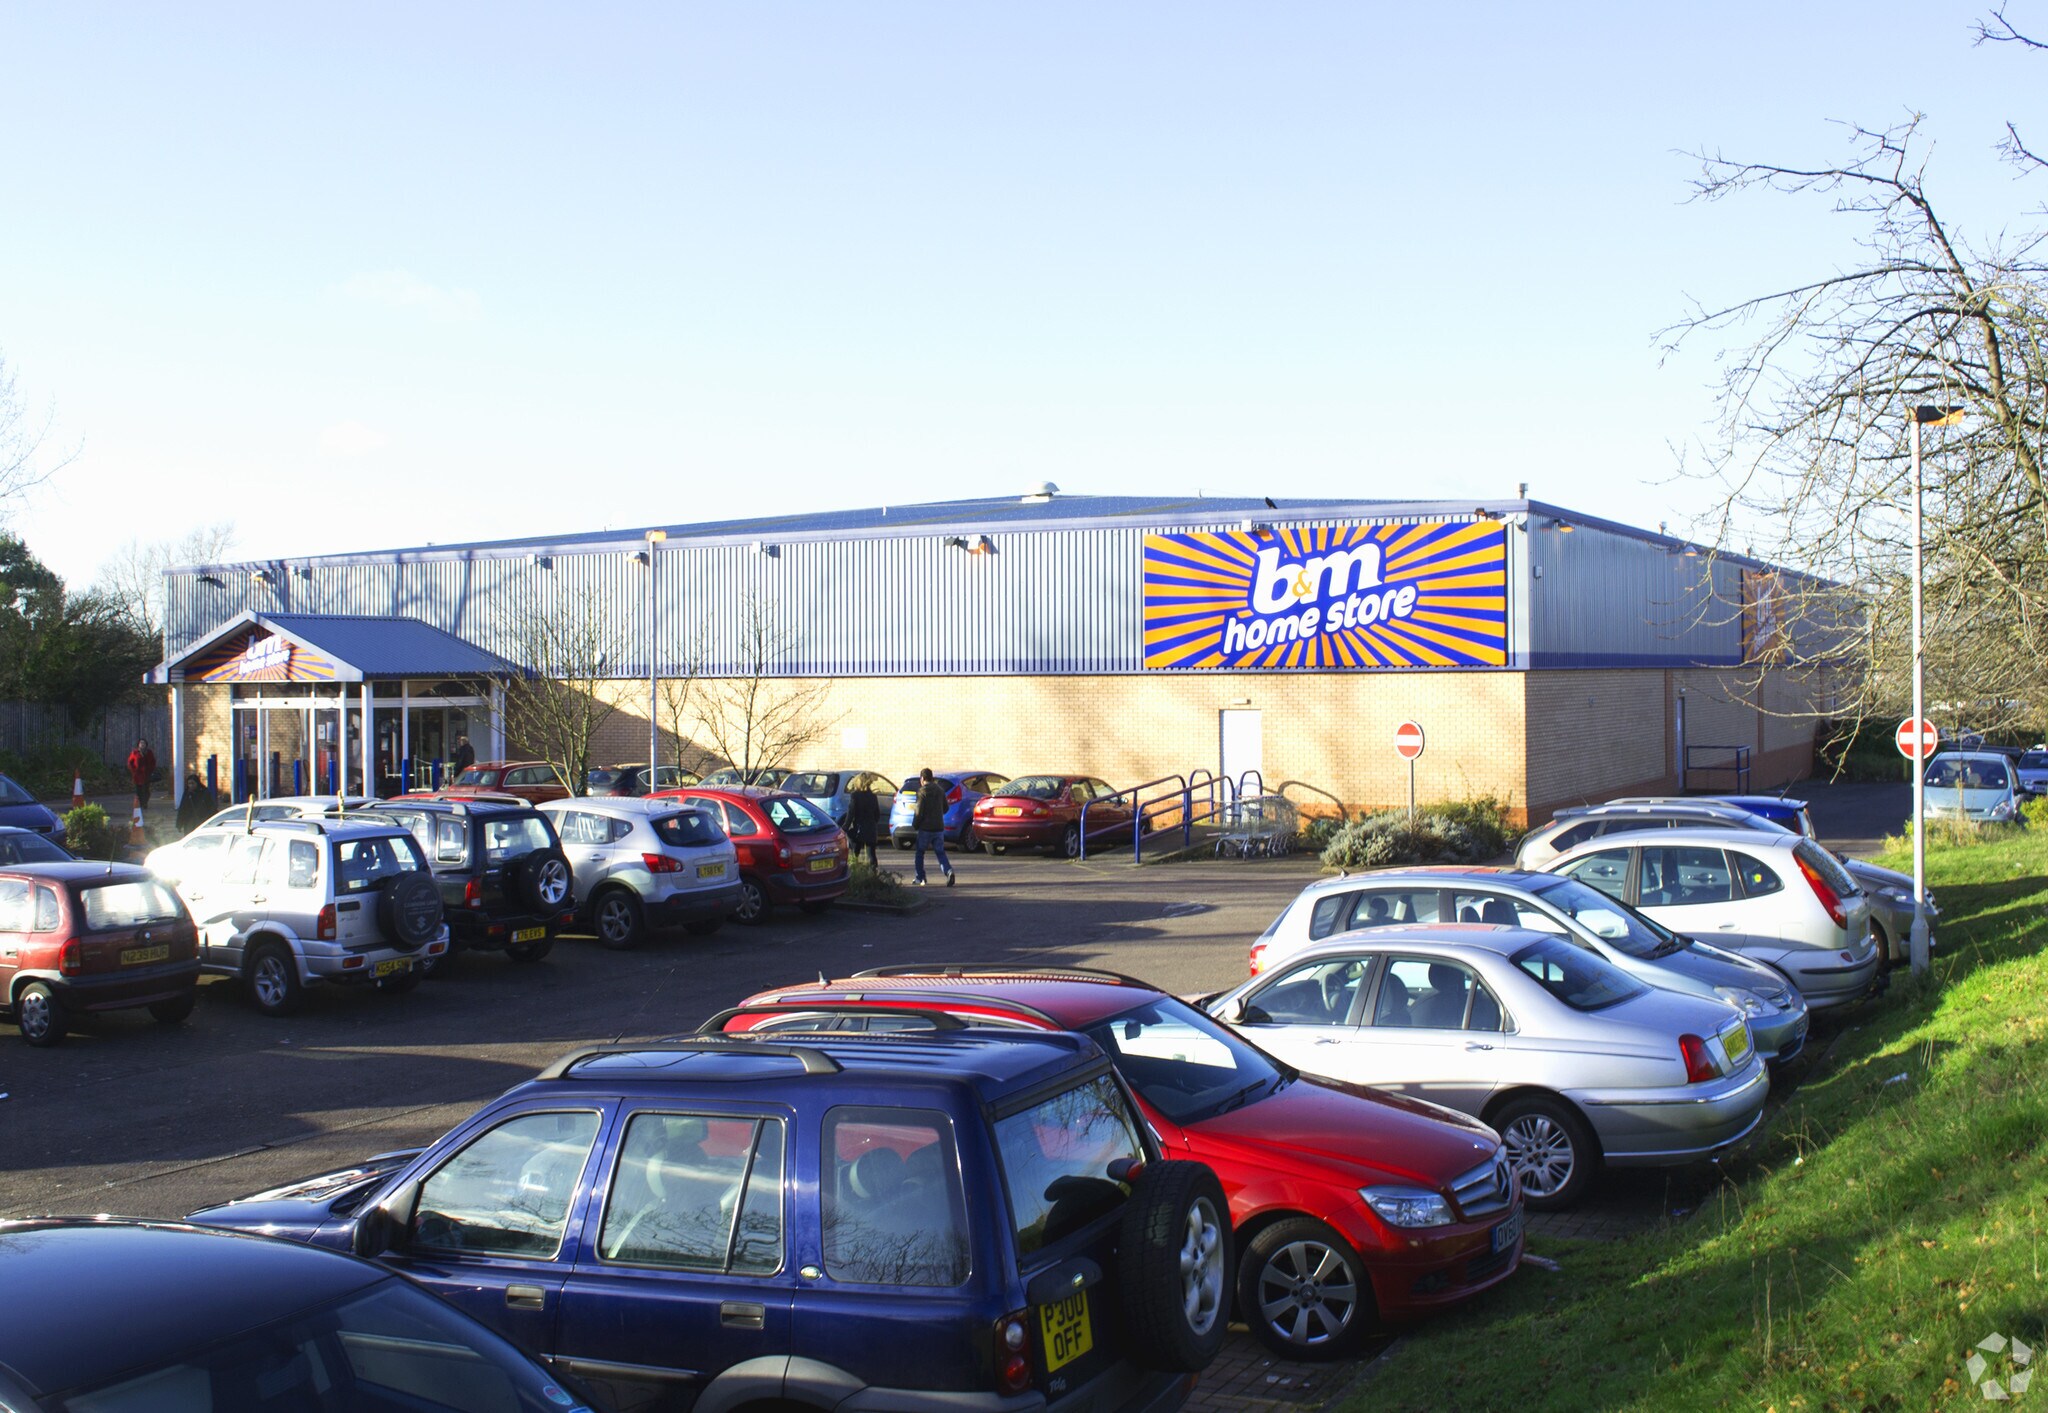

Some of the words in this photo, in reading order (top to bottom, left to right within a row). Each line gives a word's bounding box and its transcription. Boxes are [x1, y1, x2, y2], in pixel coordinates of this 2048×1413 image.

[1252, 543, 1382, 614] b&m
[1223, 607, 1320, 654] home
[1325, 586, 1416, 632] store
[123, 949, 149, 964] N239
[1044, 1292, 1085, 1333] P300
[1053, 1321, 1083, 1361] OFF
